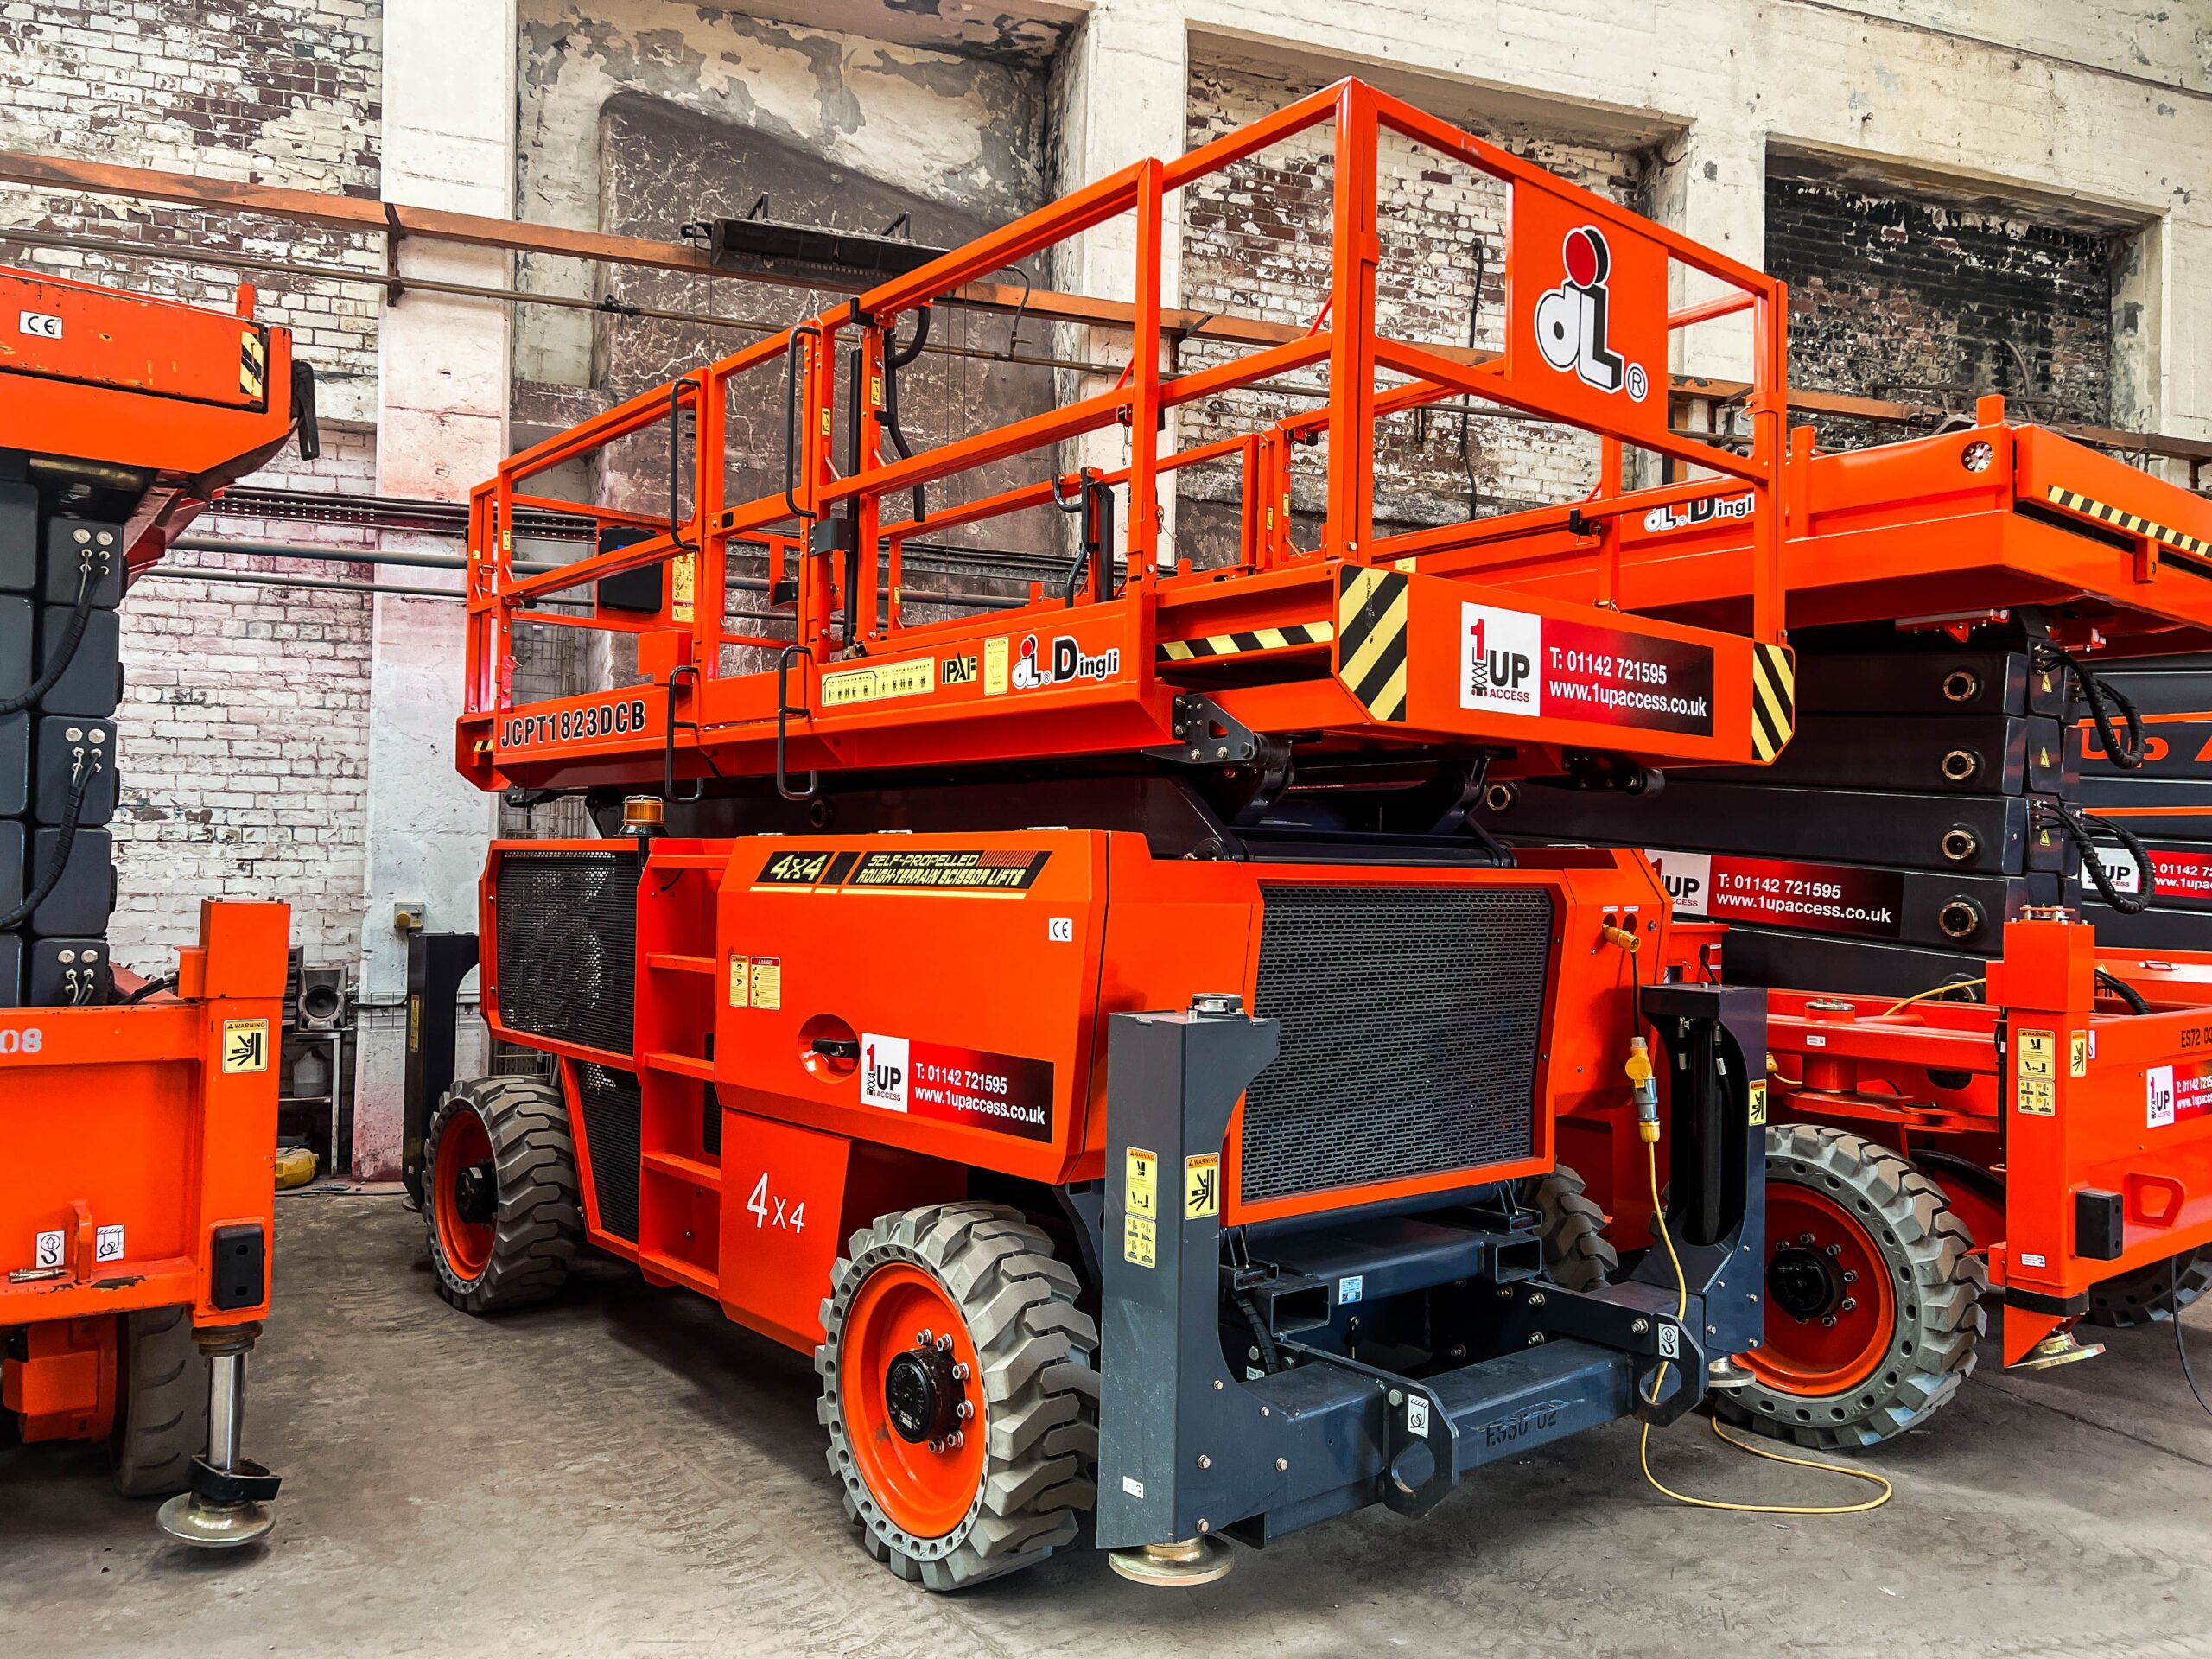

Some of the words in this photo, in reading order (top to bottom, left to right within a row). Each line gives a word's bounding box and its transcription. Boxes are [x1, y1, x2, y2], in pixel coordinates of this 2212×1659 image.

[28, 315, 55, 335] CE
[1690, 496, 1752, 522] Dingl
[942, 652, 976, 684] IPAF
[1053, 638, 1118, 682] Dingli
[1549, 646, 1563, 670] T:
[1567, 650, 1612, 677] 01142
[1617, 658, 1668, 685] 721595
[1489, 689, 1530, 702] ACCESS
[1548, 680, 1707, 717] www.1upaccess.co.uk
[500, 700, 646, 748] JCPT1823DCB
[868, 855, 980, 867] SELF-PROPELLED
[2159, 863, 2198, 876] 01142
[938, 868, 991, 885] SCISSOR
[986, 869, 1027, 886] LIFTS
[1717, 873, 1730, 888] T:
[1734, 874, 1780, 893] 01142
[1784, 880, 1842, 899] 721595
[2154, 877, 2212, 891] ww.1upa
[1672, 898, 1699, 907] CCESS
[1716, 893, 1891, 924] www.1upaccess.co.uk
[1052, 920, 1069, 938] CE
[2181, 1028, 2201, 1048] ES72
[915, 1062, 925, 1080] T:
[927, 1065, 961, 1086] 01142
[964, 1071, 1007, 1095] 721595
[2182, 1077, 2199, 1093] 01142
[876, 1090, 901, 1102] ACCESS
[914, 1086, 1046, 1125] www.1upaccess.co.uk
[1135, 1151, 1154, 1161] WARNING
[1194, 1157, 1217, 1166] WARNING
